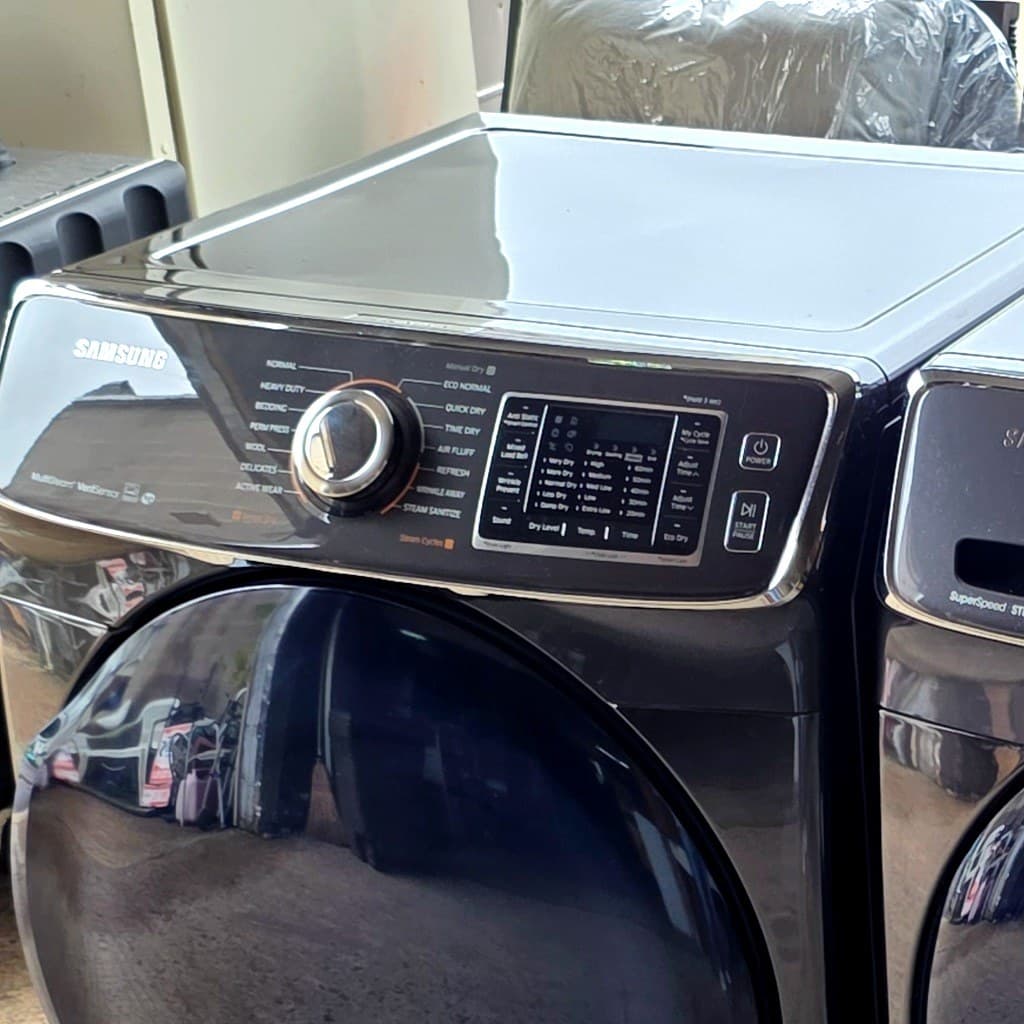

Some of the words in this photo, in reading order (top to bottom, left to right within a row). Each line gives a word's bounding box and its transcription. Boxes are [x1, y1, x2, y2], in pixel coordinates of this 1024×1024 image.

[72, 338, 169, 370] SAMSUNG
[266, 359, 297, 370] NORMAL
[260, 381, 285, 392] HEAVY
[285, 385, 306, 394] DUTY
[443, 380, 458, 390] ECO
[459, 382, 492, 393] NORMAL
[445, 403, 469, 414] QUICK
[470, 406, 487, 416] DRY
[464, 426, 481, 436] DRY
[452, 446, 476, 457] FLUFF
[745, 456, 771, 465] POWER
[240, 462, 278, 474] DELICATES
[528, 522, 541, 531] Dry
[949, 590, 1007, 613] SuperSpeed
